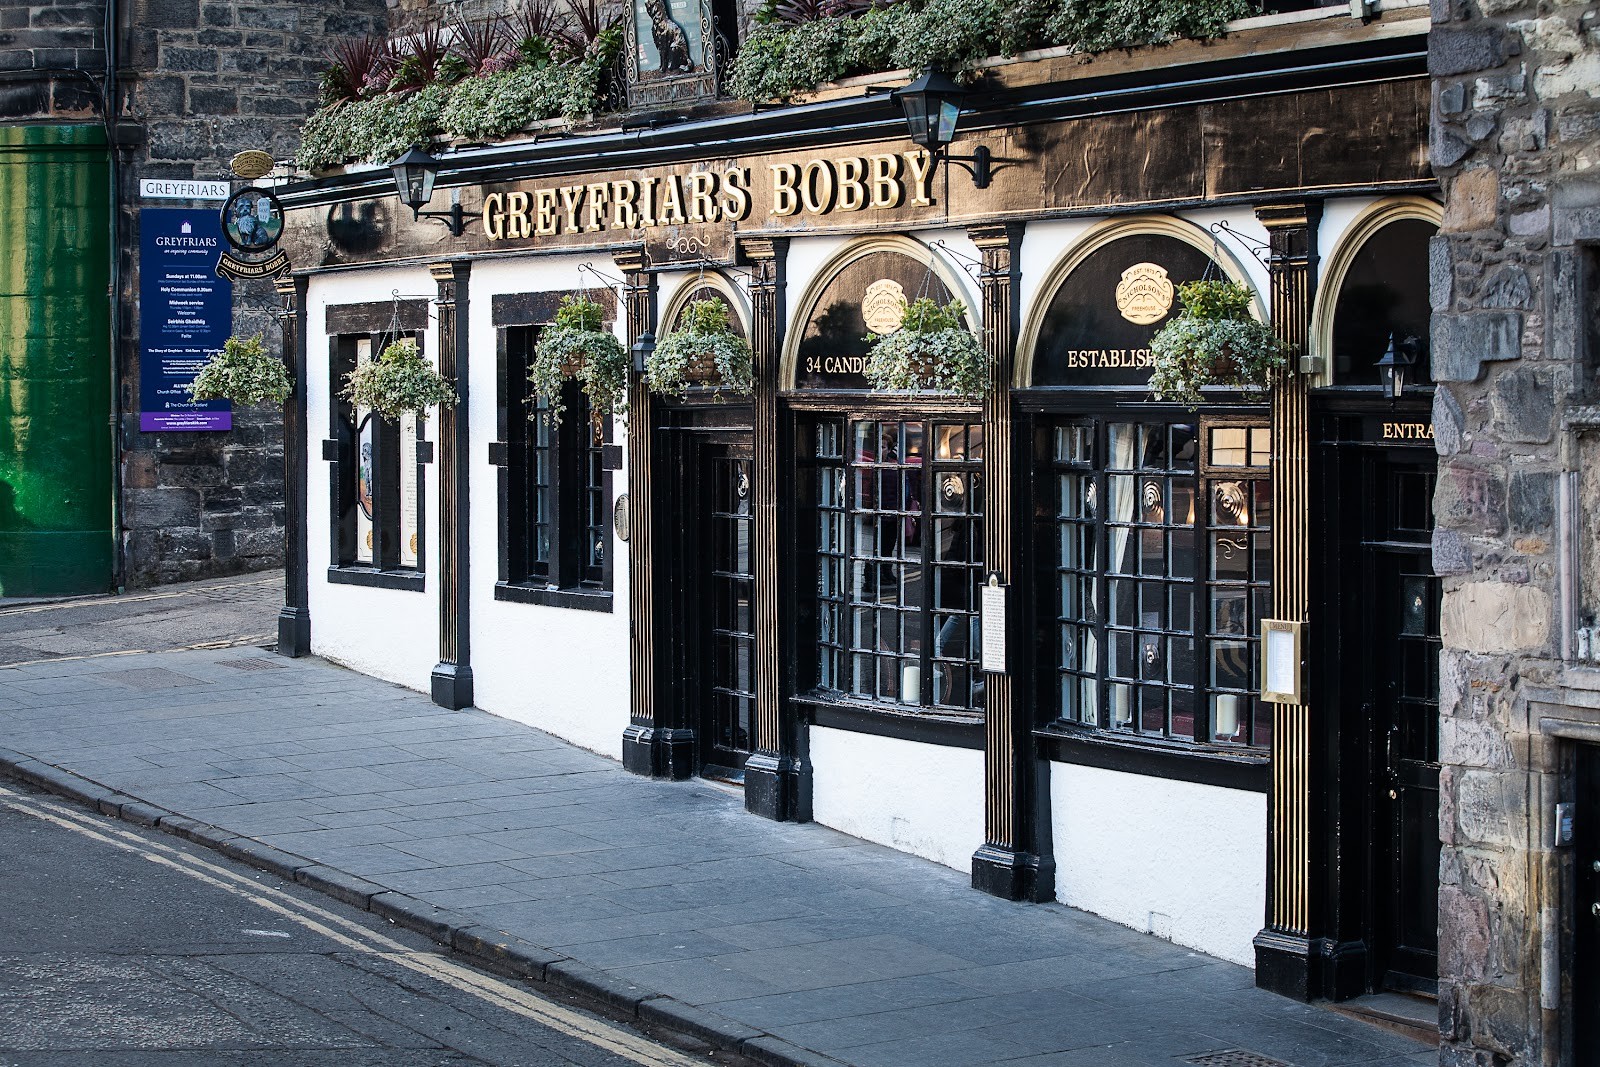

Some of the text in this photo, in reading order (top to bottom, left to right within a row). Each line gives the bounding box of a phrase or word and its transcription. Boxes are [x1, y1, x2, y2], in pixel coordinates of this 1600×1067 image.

[145, 182, 226, 196] GREYFRIARS
[482, 149, 936, 242] GREYFRIARS BOBBY
[155, 236, 217, 247] GREYFRIARS
[222, 255, 285, 274] GREYFRIARS BOBBY
[1122, 284, 1166, 304] NICHOLSON'S
[806, 356, 872, 374] 34 CANDL
[1067, 348, 1158, 368] ESTABLISH
[1382, 422, 1435, 439] ENTRA
